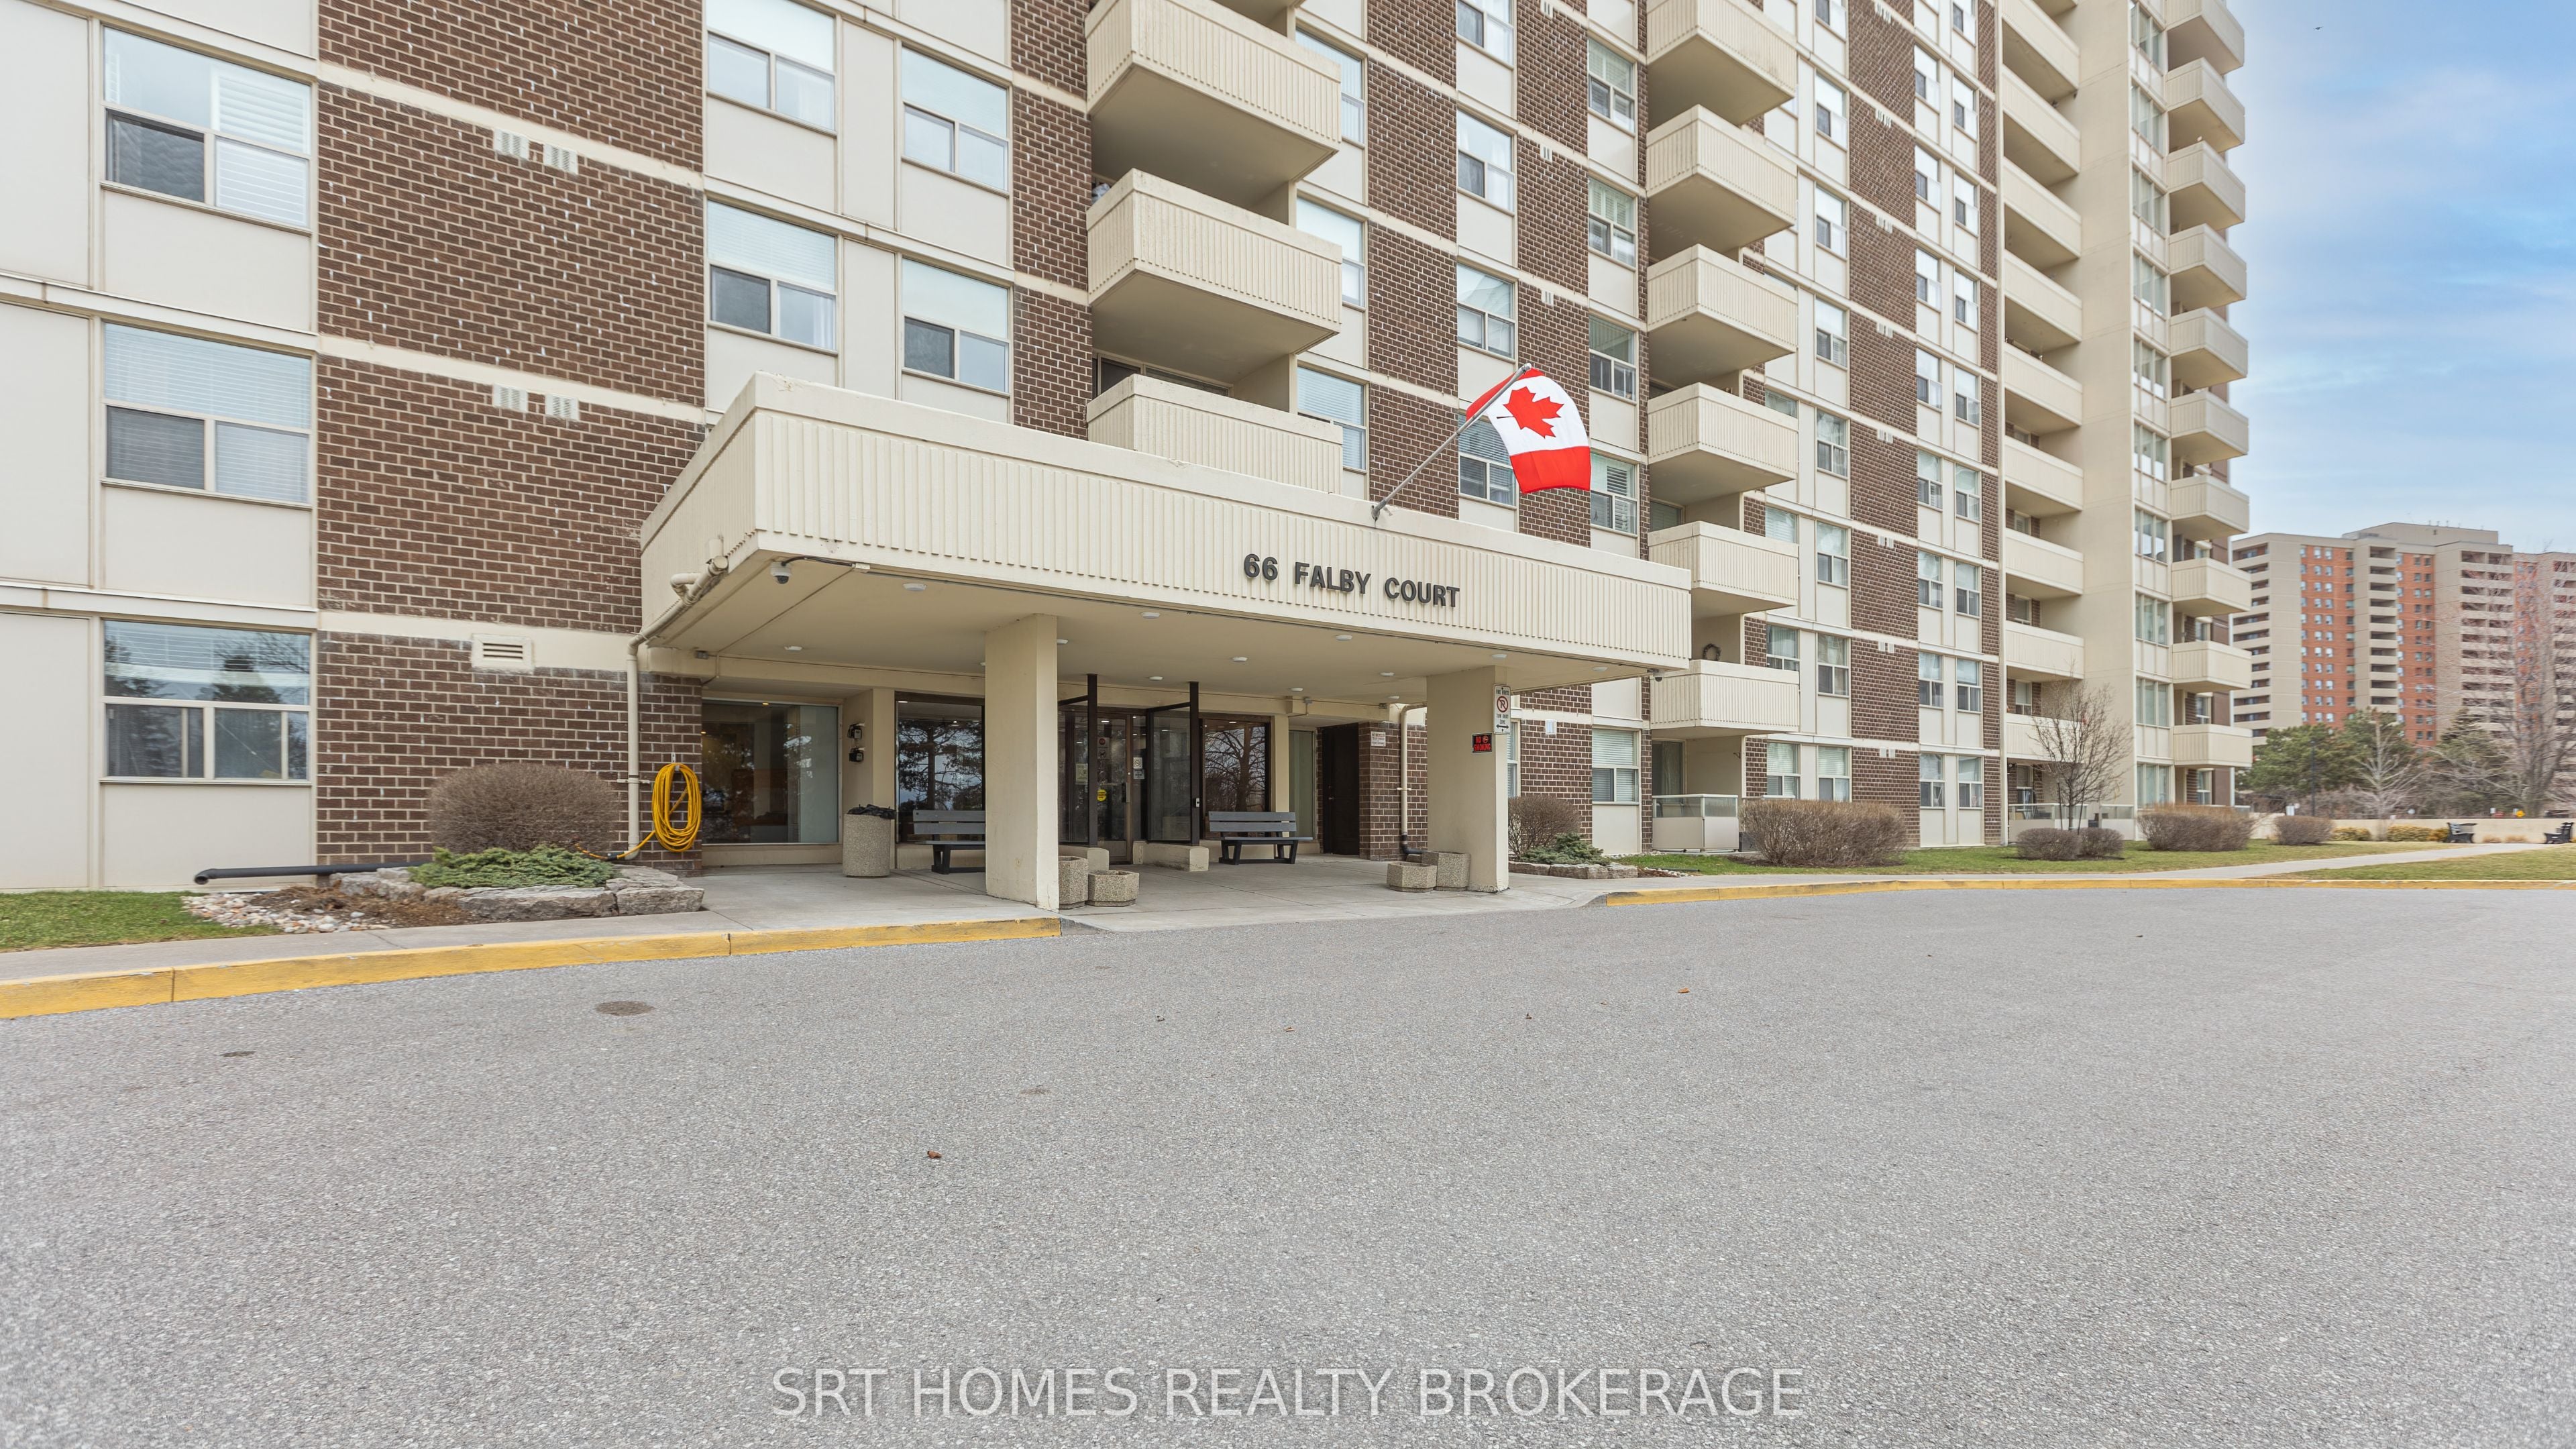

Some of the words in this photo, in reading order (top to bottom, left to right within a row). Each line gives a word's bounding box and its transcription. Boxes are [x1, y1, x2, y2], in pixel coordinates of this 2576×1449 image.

[1244, 553, 1278, 581] 66
[1295, 561, 1371, 594] FALBY
[1385, 577, 1460, 608] COURT
